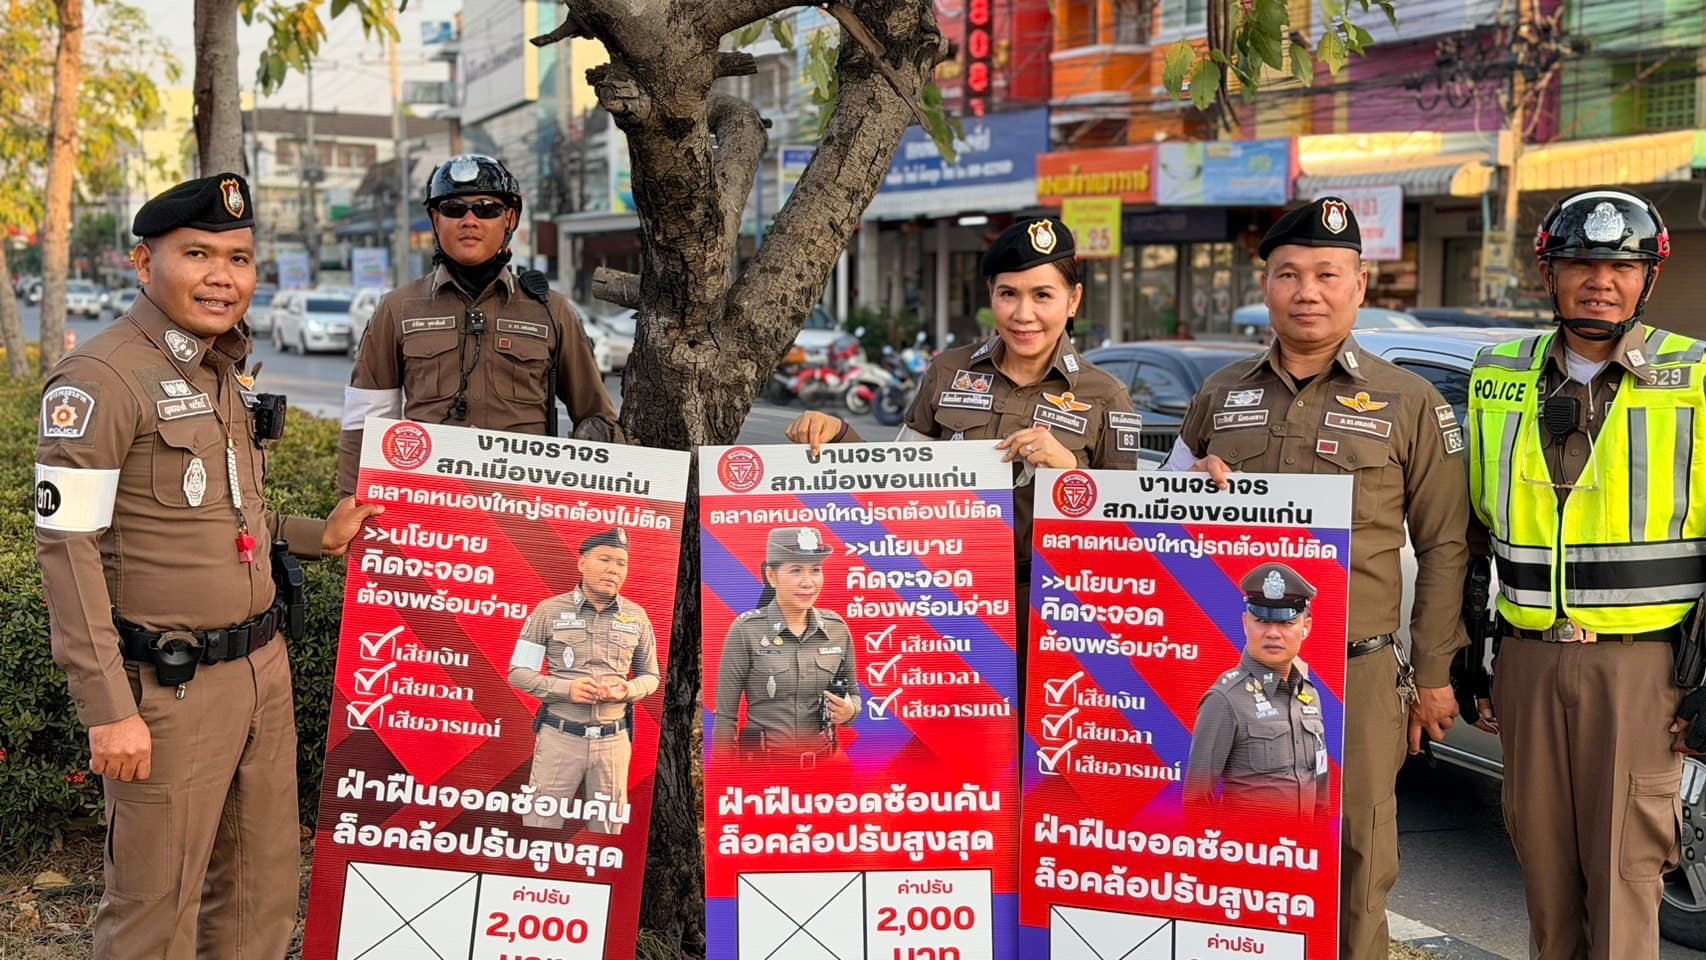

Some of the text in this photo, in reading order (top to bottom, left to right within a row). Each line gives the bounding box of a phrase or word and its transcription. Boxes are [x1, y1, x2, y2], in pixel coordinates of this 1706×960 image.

[1475, 379, 1526, 403] POLICE
[48, 427, 80, 435] POLICE
[1123, 433, 1135, 446] 63
[477, 432, 610, 464] งานจราจร
[436, 456, 650, 496] สภ.เมืองขอนแก่น
[771, 466, 977, 492] สภ.เมืองขอนแก่น
[368, 484, 673, 531] ตลาดหนองใหญ่รถต้องไม่ติด
[710, 498, 1001, 525] ตลาดหนองใหญ่รถต้องไม่ติด
[1103, 497, 1313, 525] สภ.เมืองขอนแก่น
[1042, 532, 1338, 561] ตลาดหนองใหญ่รถต้องไม่ติด
[360, 549, 496, 585] คิดจะจอด
[846, 567, 974, 591] คิดจะจอด
[356, 582, 528, 620] ต้องพร้อมจ่าย
[846, 595, 1009, 618] ต้องพร้อมจ่าย
[1040, 596, 1164, 627] คิดจะจอด
[396, 644, 469, 668] เสียเงิน
[901, 636, 971, 654] เสียเงิน
[1038, 629, 1198, 661] ต้องพร้อมจ่าย
[391, 677, 474, 702] เสียเวลา
[901, 668, 980, 687] เสียเวลา
[901, 696, 1012, 719] เสียอารมณ์
[1076, 690, 1146, 711] เสียเงิน
[388, 710, 502, 738] เสียอารมณ์
[1075, 722, 1153, 746] เสียเวลา
[1074, 754, 1182, 782] เสียอารมณ์
[337, 768, 631, 825] ฝ่าฝืนจอดซ้อนคัน
[718, 783, 1000, 817] ฝ่าฝืนจอดซ้อนคัน
[332, 813, 623, 876] ล็อคล้อปรับสูงสุด
[718, 824, 994, 863] ล็อคล้อปรับสูงสุด
[1034, 812, 1320, 872] ฝ่าฝืนจอดซ้อนคัน
[512, 886, 571, 906] ค่าปรับ
[897, 879, 954, 895] ค่าปรับ
[1034, 856, 1315, 926] ล็อคล้อปรับสูงสุด
[485, 911, 589, 944] 2,000
[877, 905, 976, 936] 2,000
[1206, 933, 1264, 955] ค่าปรับ
